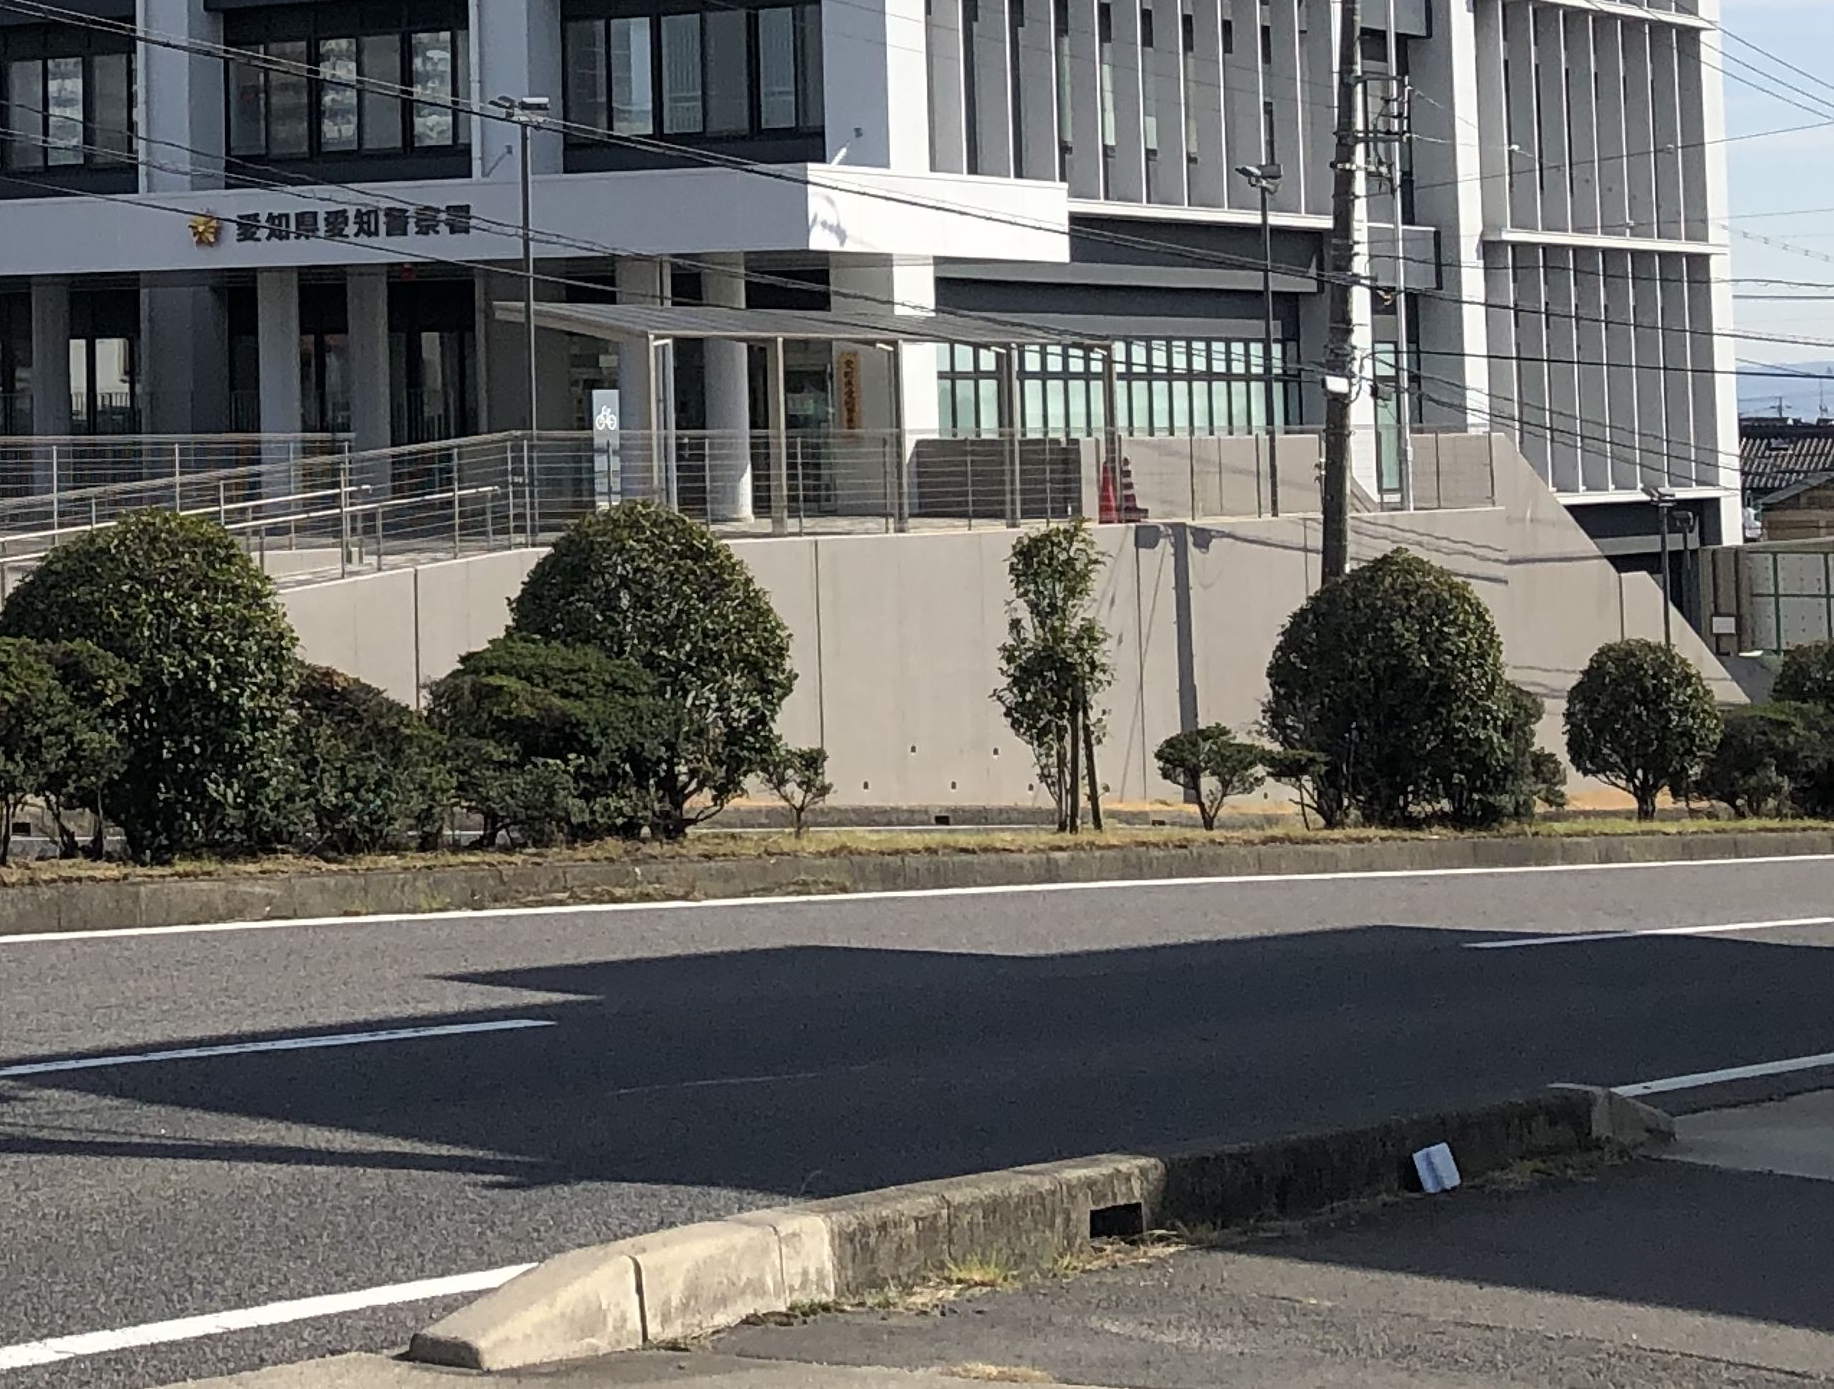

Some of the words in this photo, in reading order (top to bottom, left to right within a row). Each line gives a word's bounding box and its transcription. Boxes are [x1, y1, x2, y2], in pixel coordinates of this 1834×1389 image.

[236, 204, 472, 243] 愛知県愛知警察署
